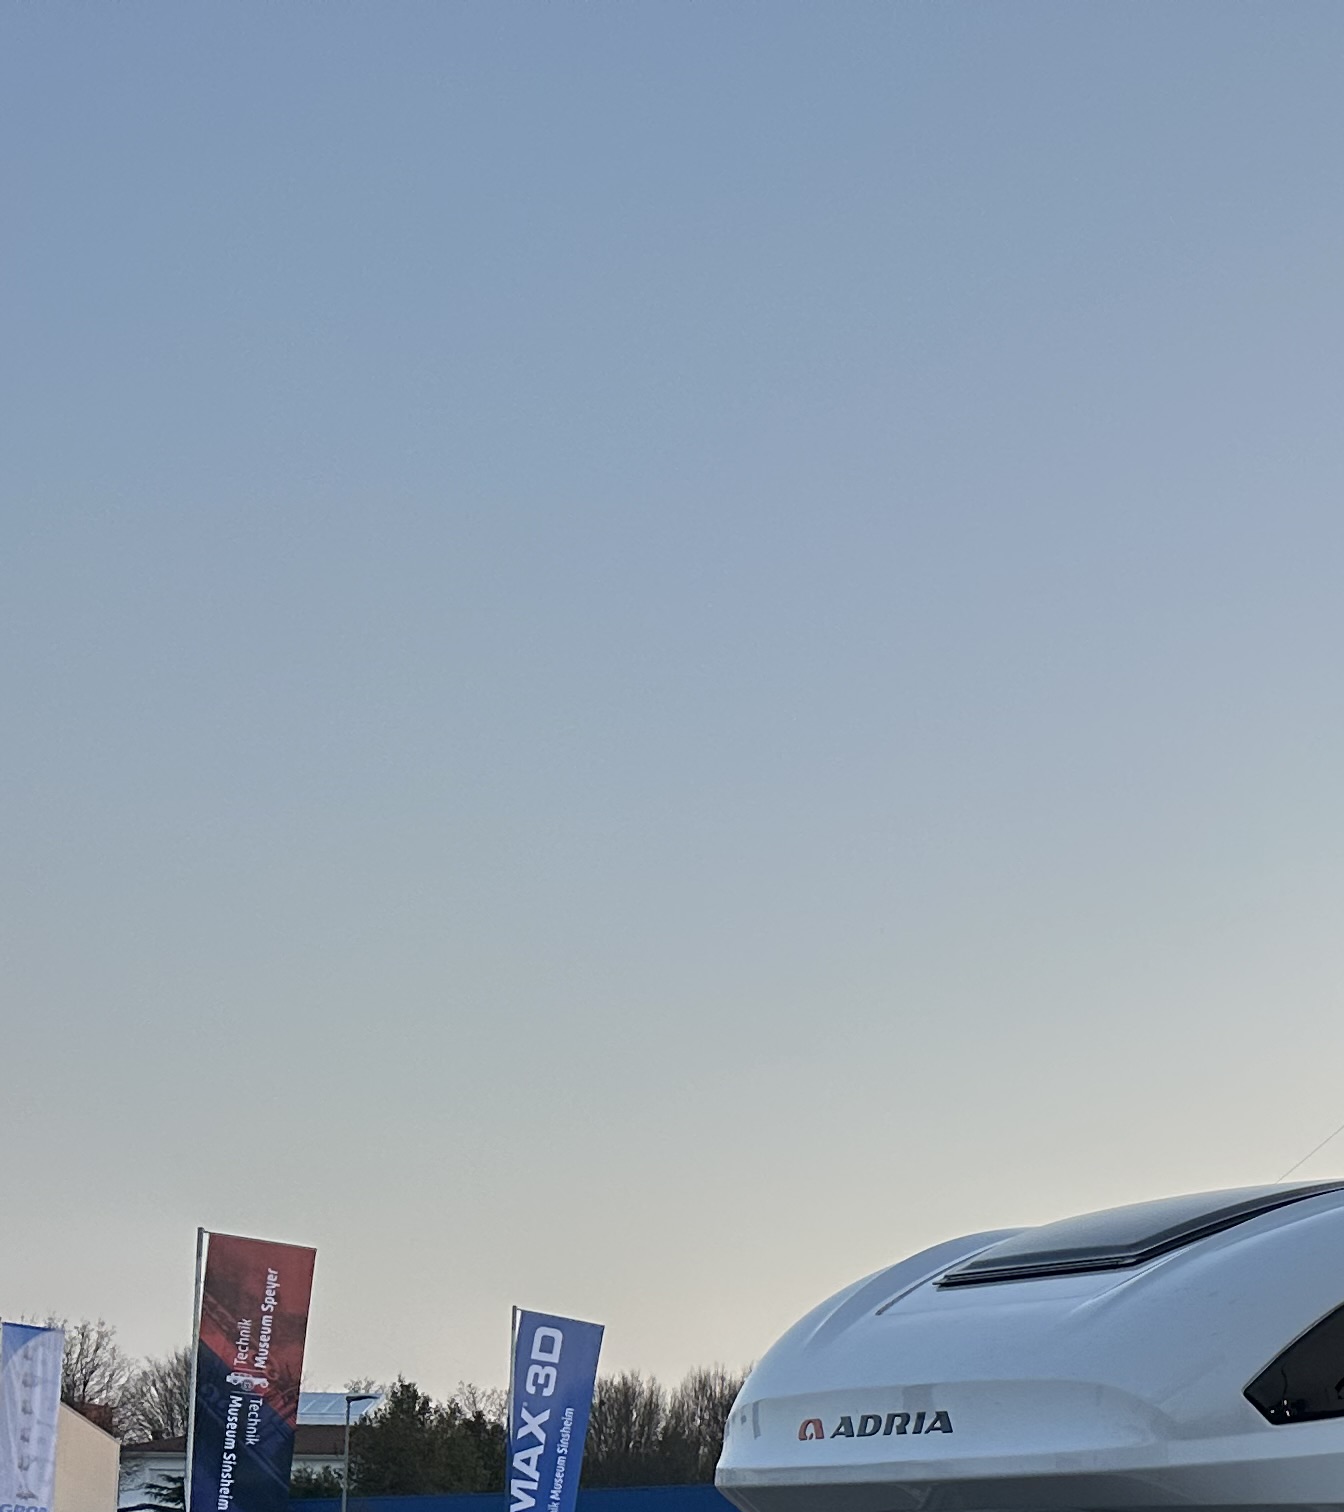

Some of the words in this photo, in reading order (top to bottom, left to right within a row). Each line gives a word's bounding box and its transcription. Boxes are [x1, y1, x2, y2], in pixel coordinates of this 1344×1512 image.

[260, 1267, 281, 1314] Speyer
[233, 1317, 253, 1367] Technik
[254, 1315, 274, 1370] Museum
[525, 1325, 564, 1397] 3D
[223, 1394, 243, 1450] Museum
[244, 1397, 263, 1446] Technik
[557, 1406, 575, 1454] Sinsheim
[830, 1410, 953, 1439] ADRIA
[217, 1450, 237, 1512] Sinsheim
[550, 1455, 567, 1502] Museum
